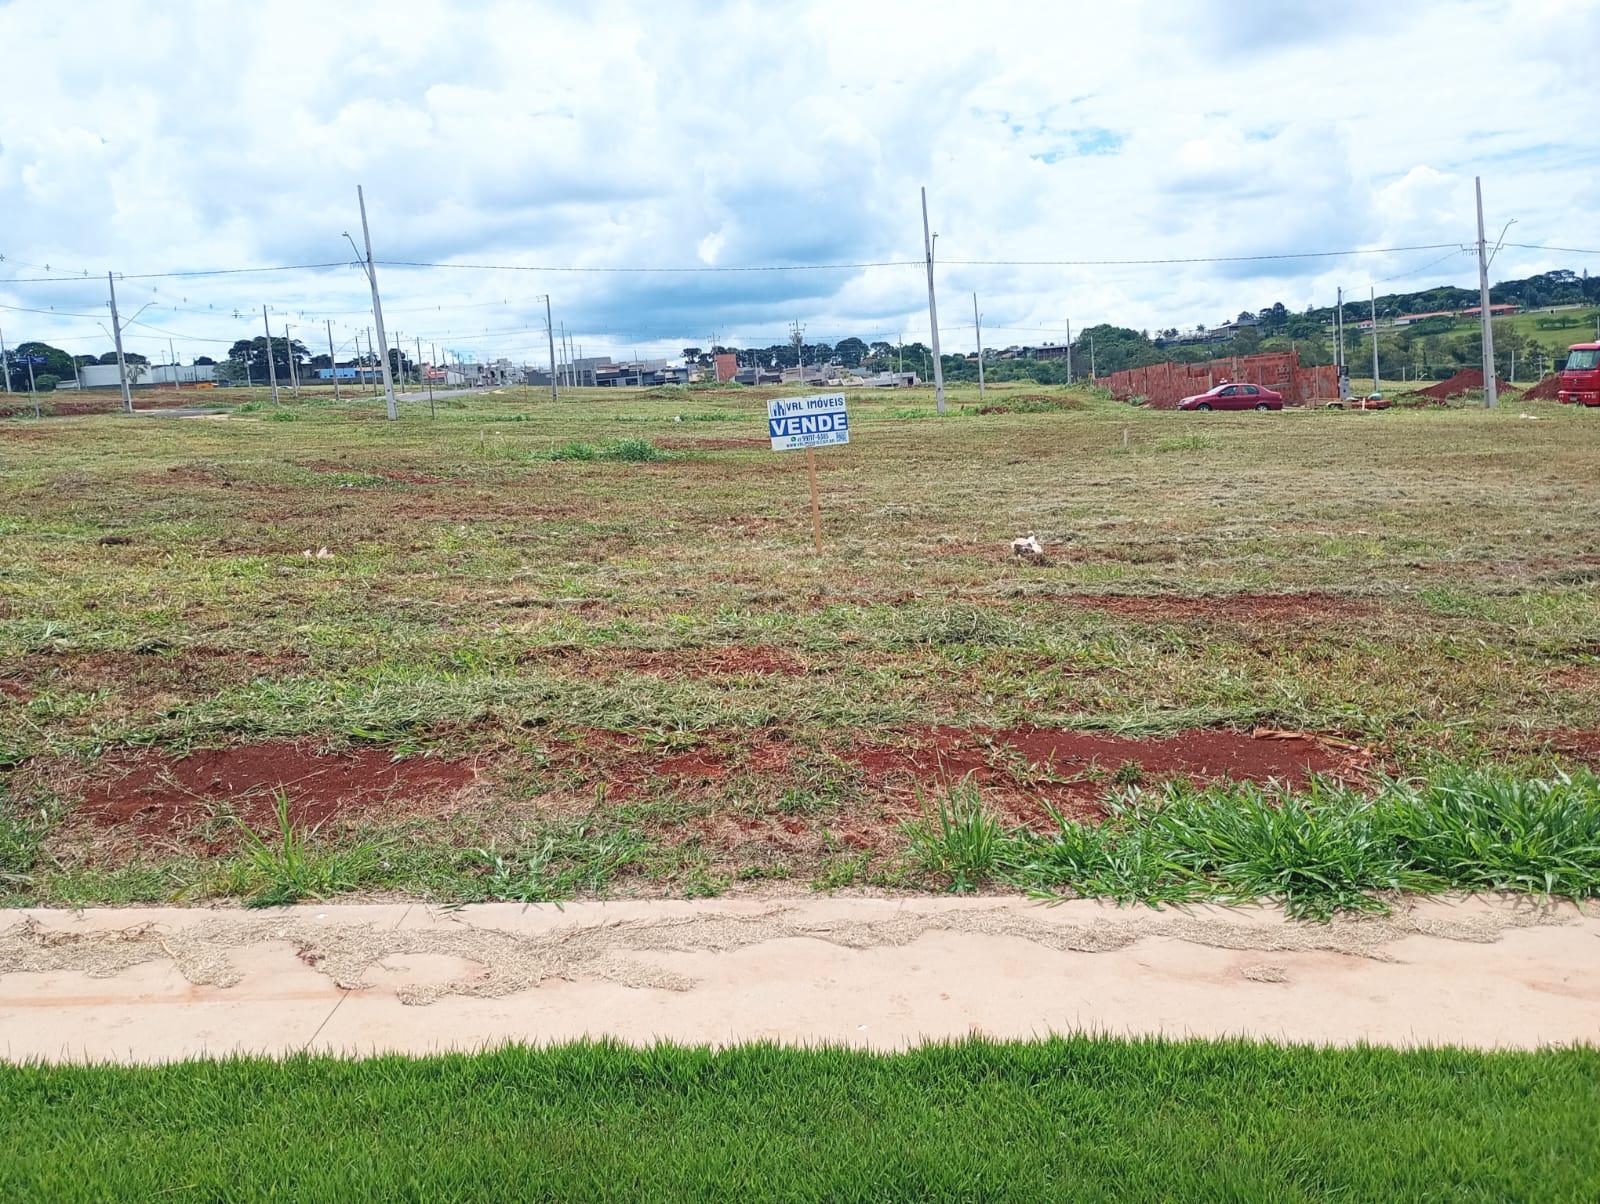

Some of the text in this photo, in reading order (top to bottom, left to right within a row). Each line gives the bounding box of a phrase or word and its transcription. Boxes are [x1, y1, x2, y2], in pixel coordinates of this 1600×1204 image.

[786, 397, 844, 411] VRL IMÓVEIS
[770, 413, 846, 435] VENDE
